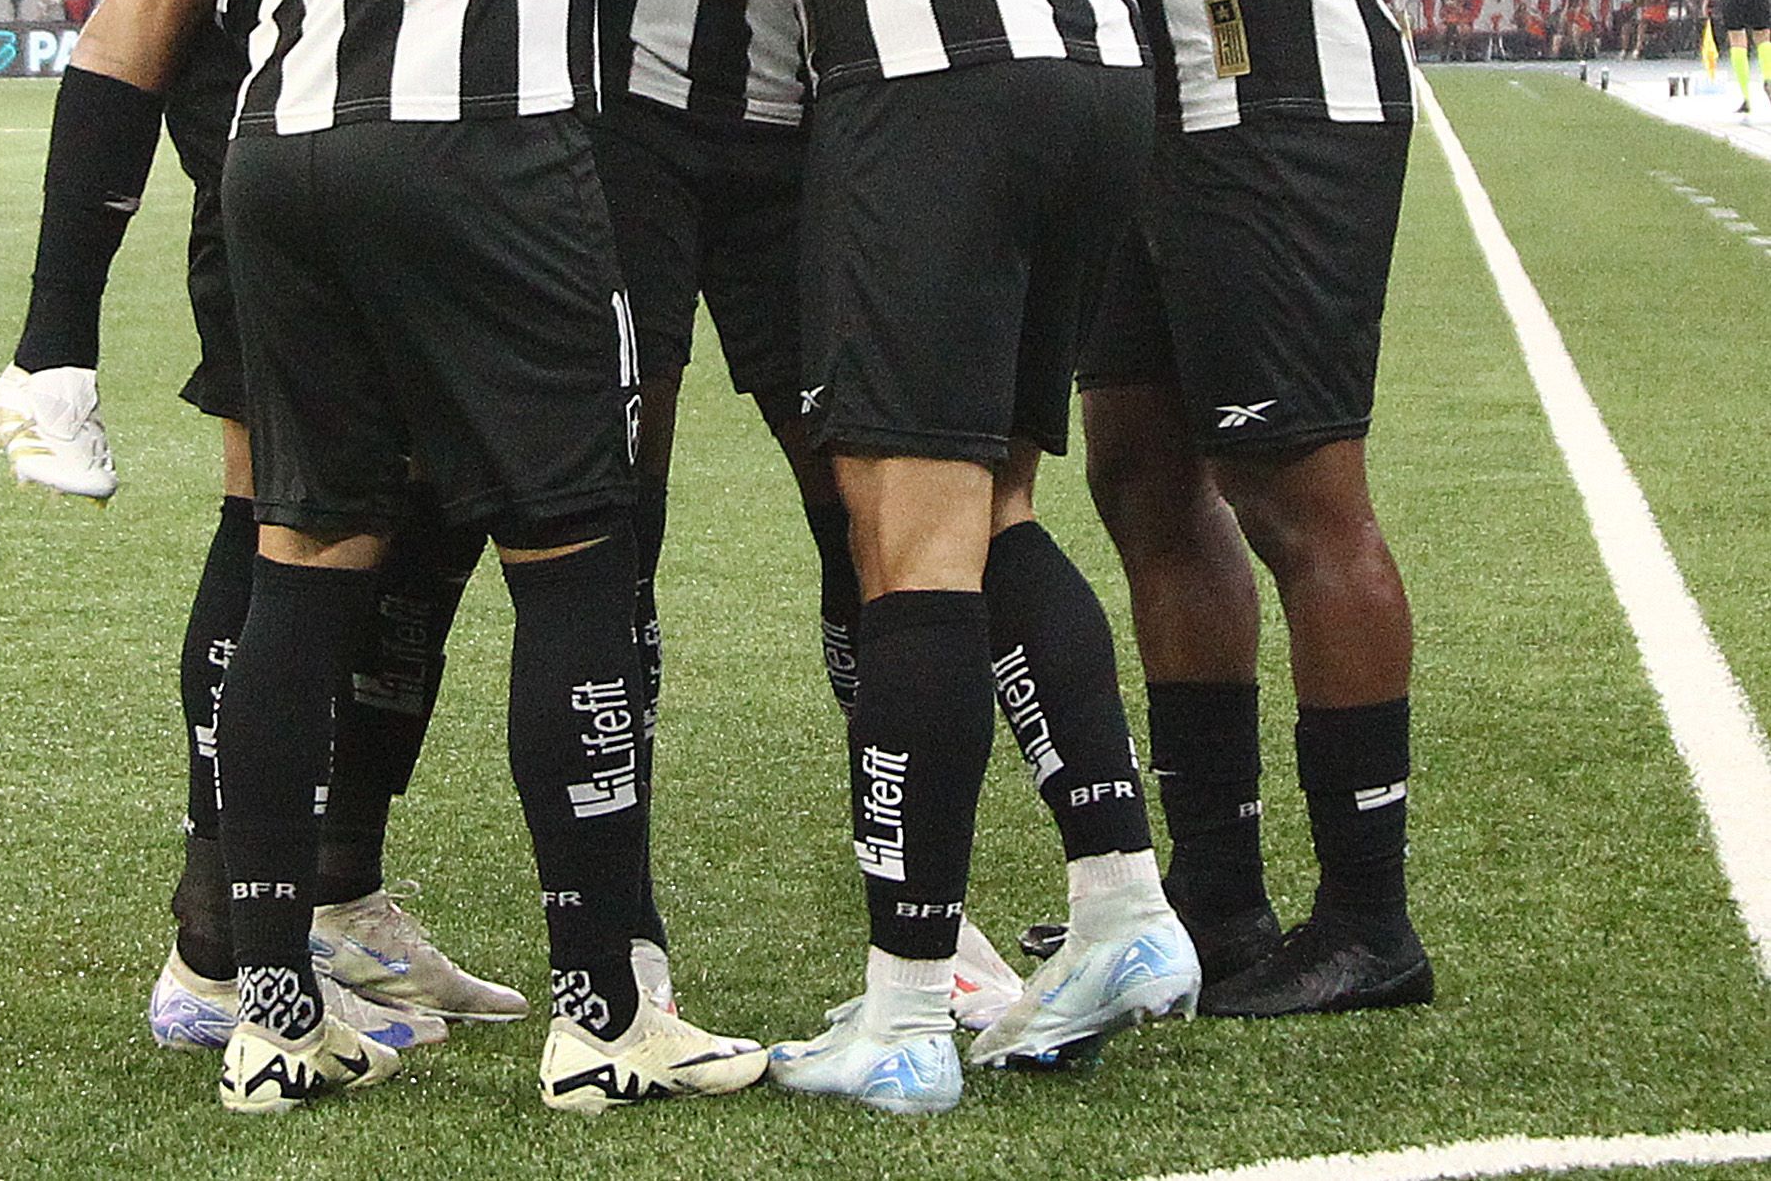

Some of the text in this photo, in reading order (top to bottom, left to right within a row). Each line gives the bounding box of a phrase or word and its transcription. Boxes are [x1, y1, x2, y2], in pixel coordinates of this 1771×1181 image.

[571, 677, 636, 780] Lifefit
[862, 744, 909, 850] Lifefit
[1070, 780, 1136, 807] BFR
[231, 882, 297, 901] BFR
[895, 901, 964, 919] BFR
